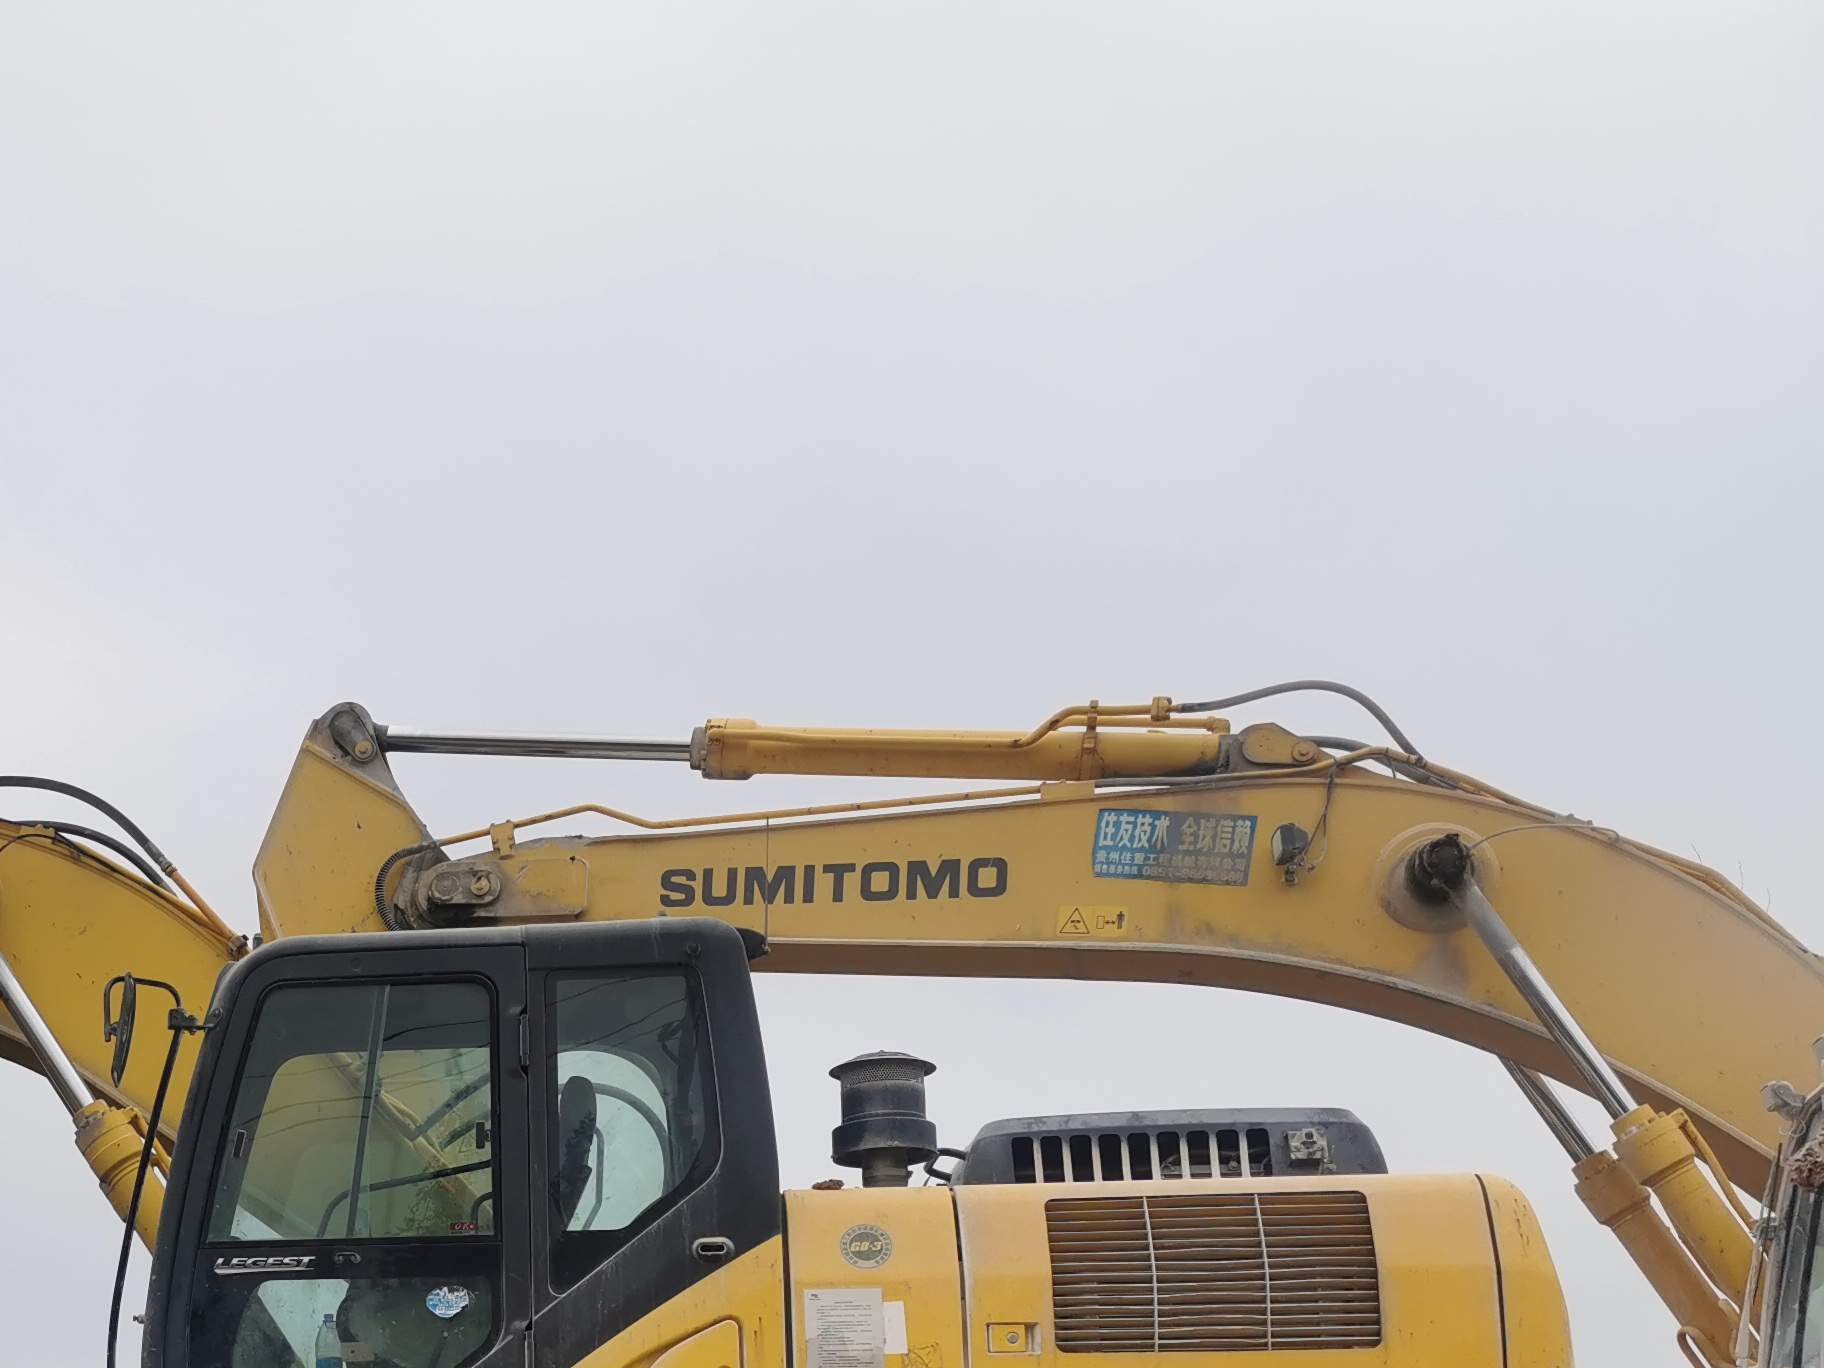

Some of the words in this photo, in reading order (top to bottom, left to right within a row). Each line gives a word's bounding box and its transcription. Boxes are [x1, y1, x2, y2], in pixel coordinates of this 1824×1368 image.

[1099, 812, 1171, 849] 住友技术
[1177, 816, 1252, 855] 全球信赖
[659, 856, 1009, 908] SUMITOMO
[215, 1256, 317, 1271] LEGEST
